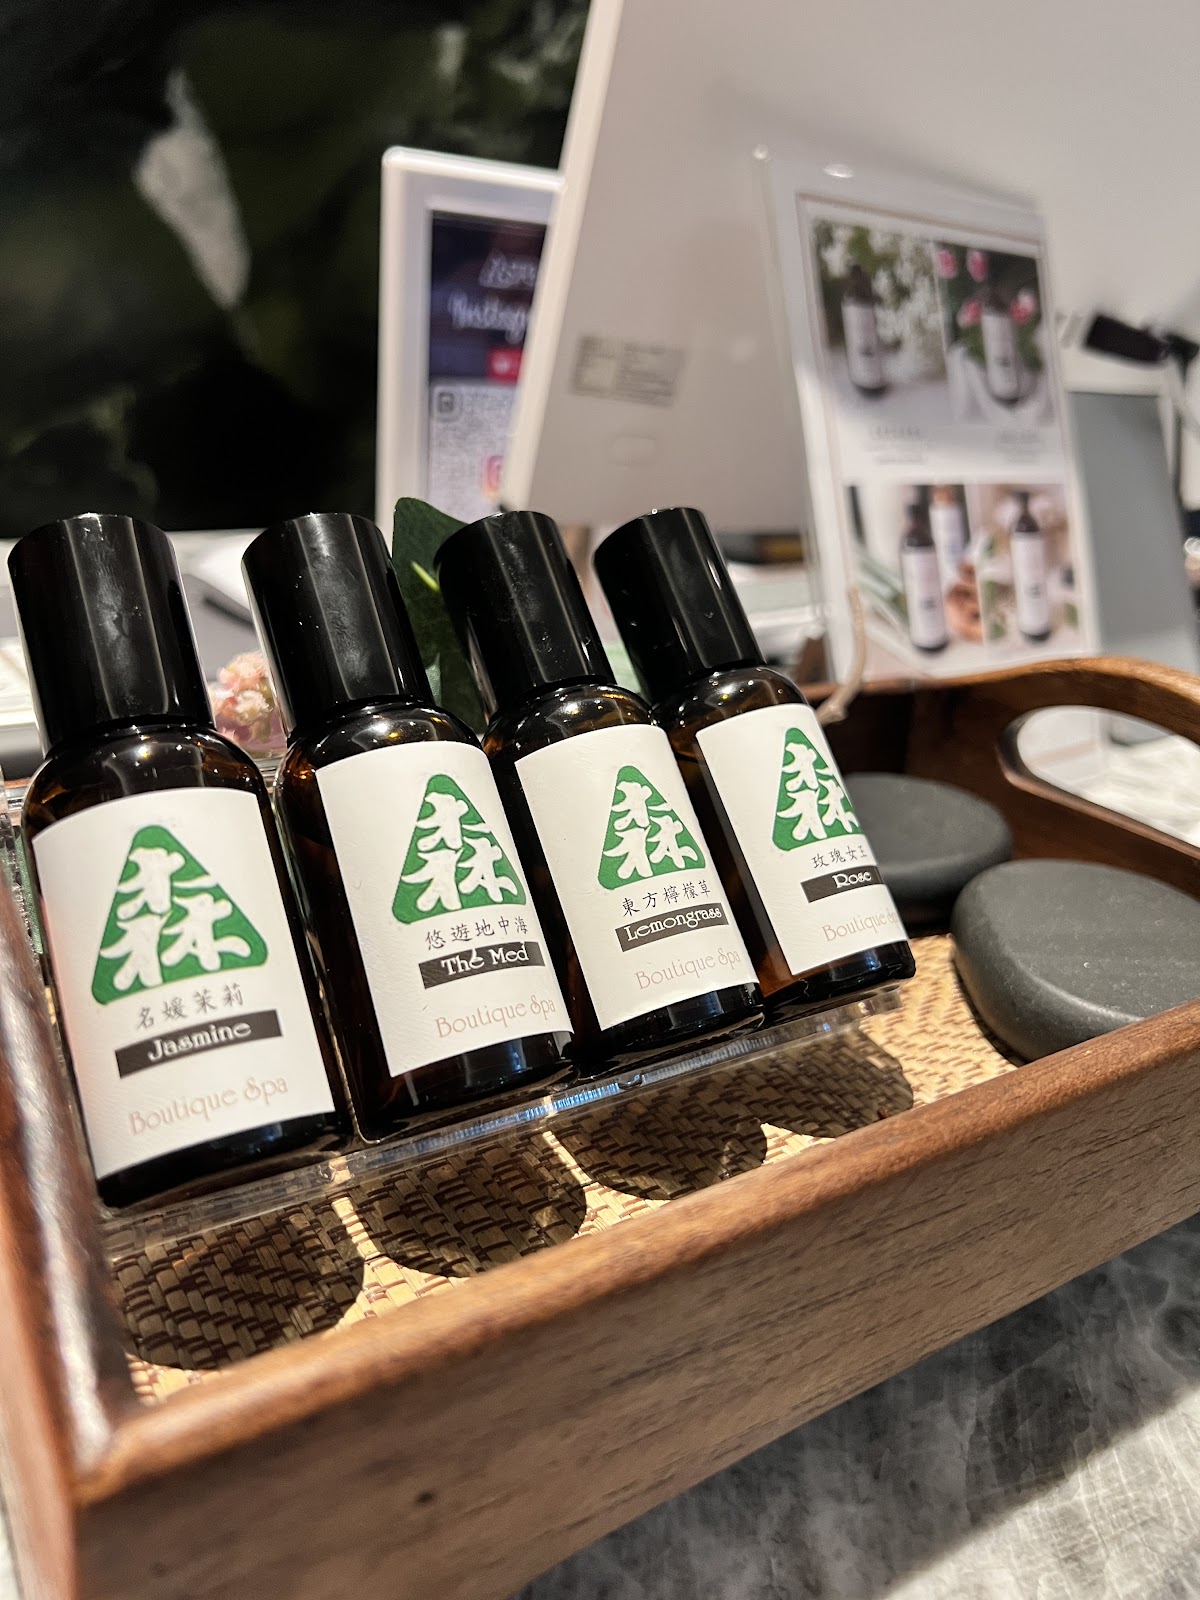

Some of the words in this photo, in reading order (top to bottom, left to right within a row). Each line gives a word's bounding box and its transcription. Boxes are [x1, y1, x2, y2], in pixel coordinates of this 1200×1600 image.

[811, 845, 868, 869] 玫瑰女王
[832, 871, 872, 888] Rose
[622, 879, 711, 918] 東方檸檬草
[425, 915, 529, 951] 悠遊地中海
[623, 907, 722, 942] Lemongrass
[821, 912, 886, 942] Boutique
[441, 952, 485, 976] The
[488, 943, 530, 966] Med
[635, 955, 715, 990] Boutique
[717, 947, 741, 971] Spa
[136, 982, 245, 1032] 名媛茉莉
[435, 1002, 527, 1038] Boutique
[529, 994, 556, 1020] Spa
[147, 1021, 252, 1062] Jasmine
[128, 1088, 239, 1136] Boutique
[243, 1075, 289, 1105] Spa
